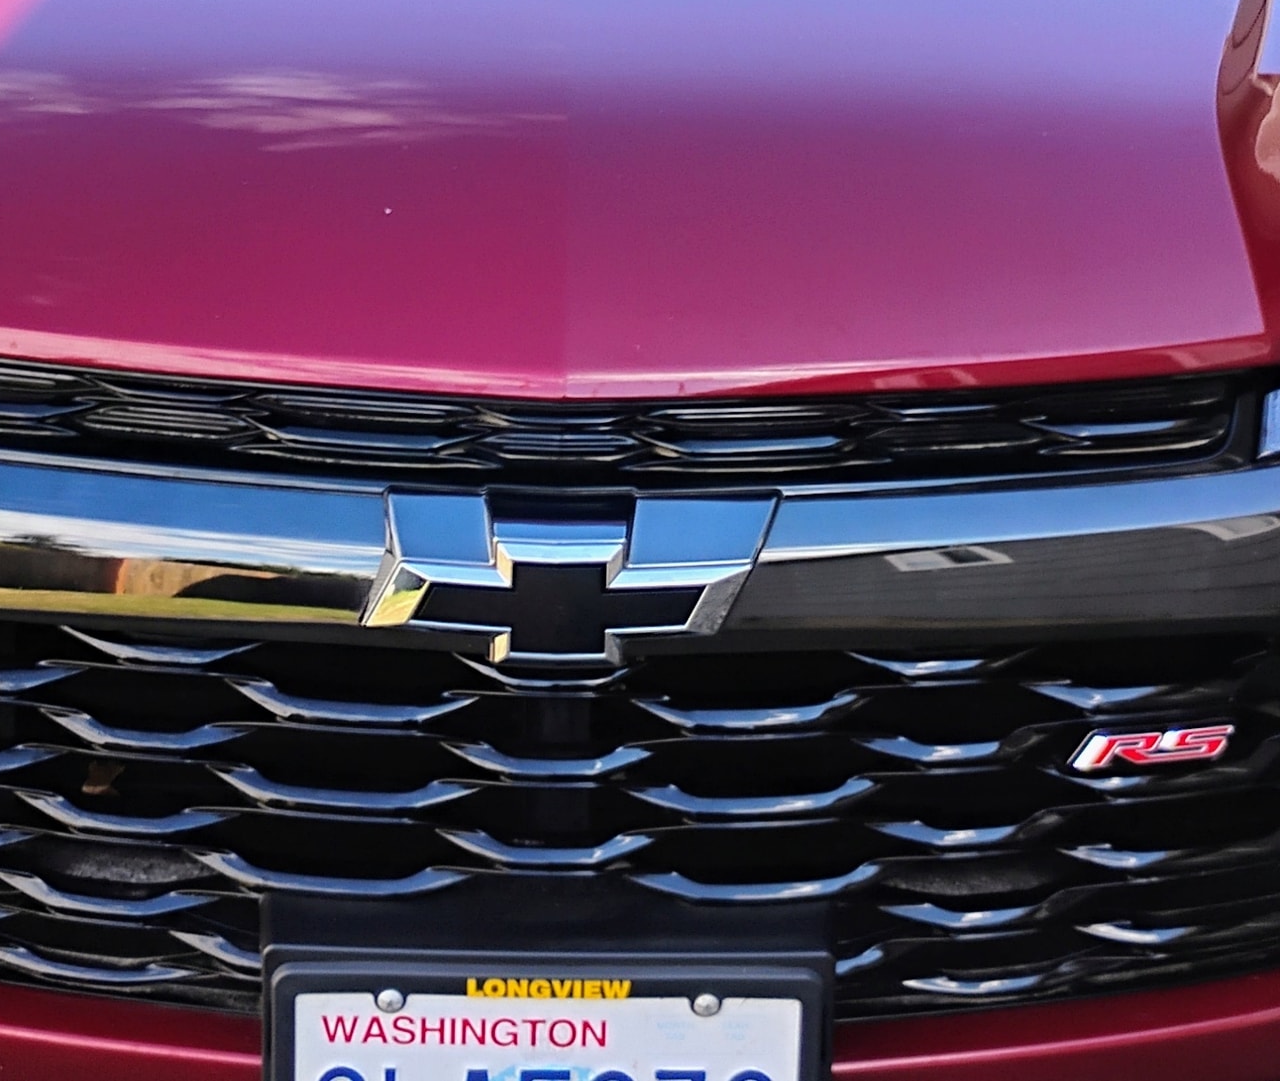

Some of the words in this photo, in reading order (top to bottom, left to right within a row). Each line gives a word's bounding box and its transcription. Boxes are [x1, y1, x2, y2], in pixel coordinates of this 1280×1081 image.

[1075, 725, 1234, 769] RS
[466, 977, 632, 999] LONGVIEW
[321, 1015, 607, 1047] WASHINGTON
